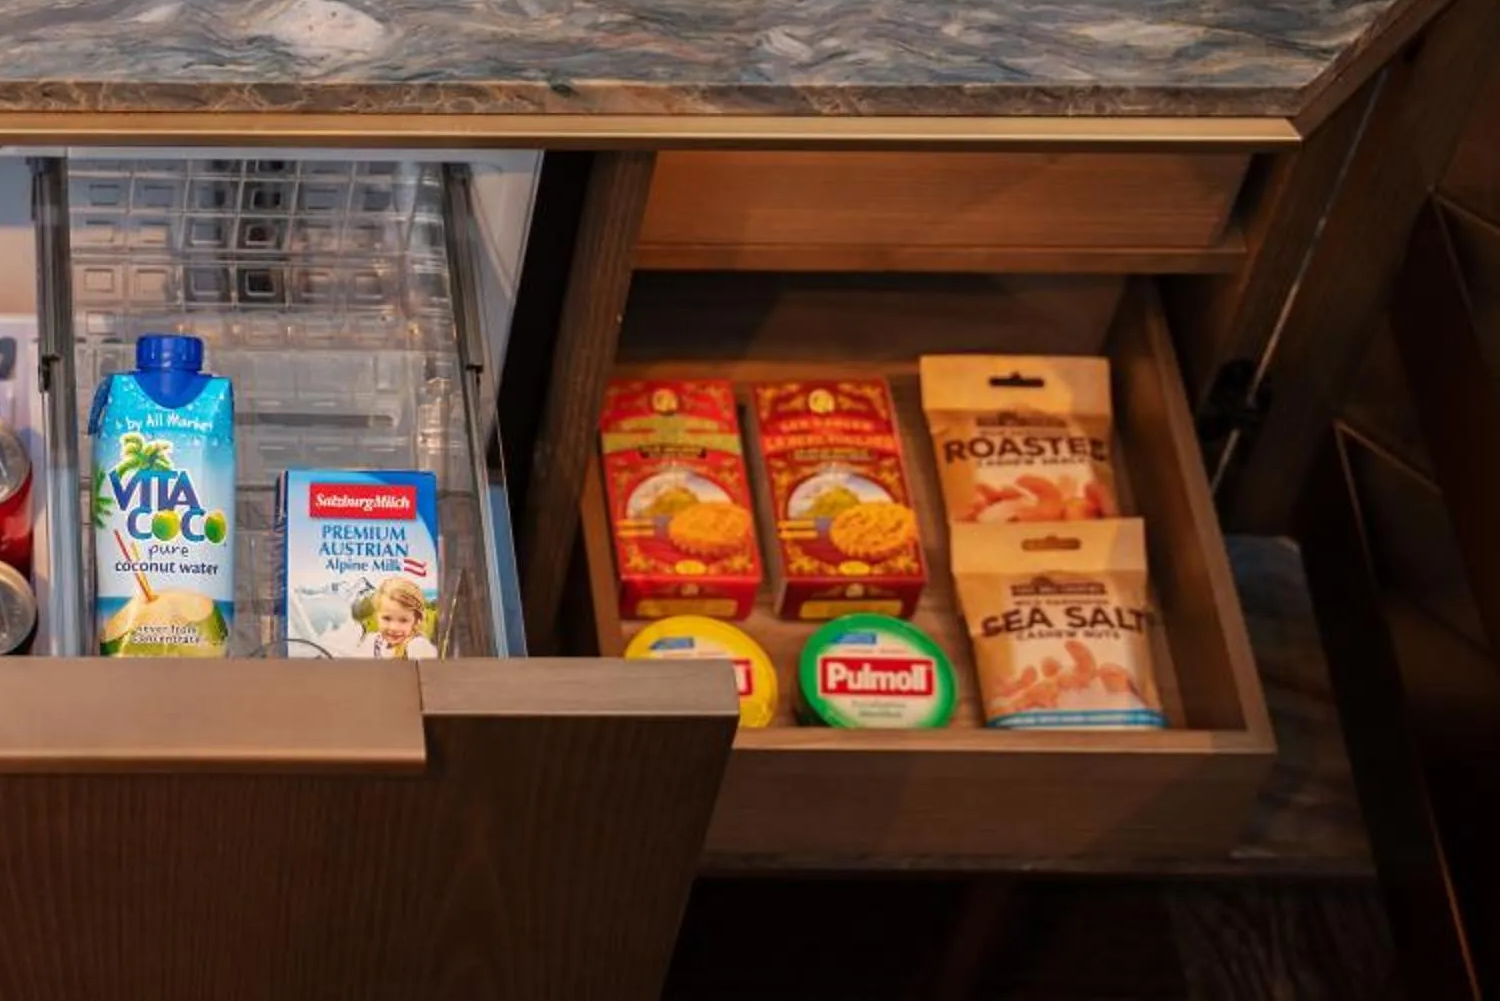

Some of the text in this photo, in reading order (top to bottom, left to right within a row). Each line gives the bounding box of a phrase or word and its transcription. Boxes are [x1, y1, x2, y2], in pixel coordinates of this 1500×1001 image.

[126, 417, 142, 431] by
[146, 413, 163, 428] All
[108, 470, 201, 511] VITA
[315, 493, 411, 512] SalzburgMilch
[322, 525, 406, 541] PREMIUM
[150, 544, 189, 558] pure
[319, 542, 409, 557] AUSTRIAN
[115, 560, 219, 576] coconut water
[325, 558, 402, 573] Alpine Milk
[981, 606, 1146, 638] SEA SALT
[1016, 630, 1077, 641] CASHEW
[827, 662, 927, 691] Pulmoll
